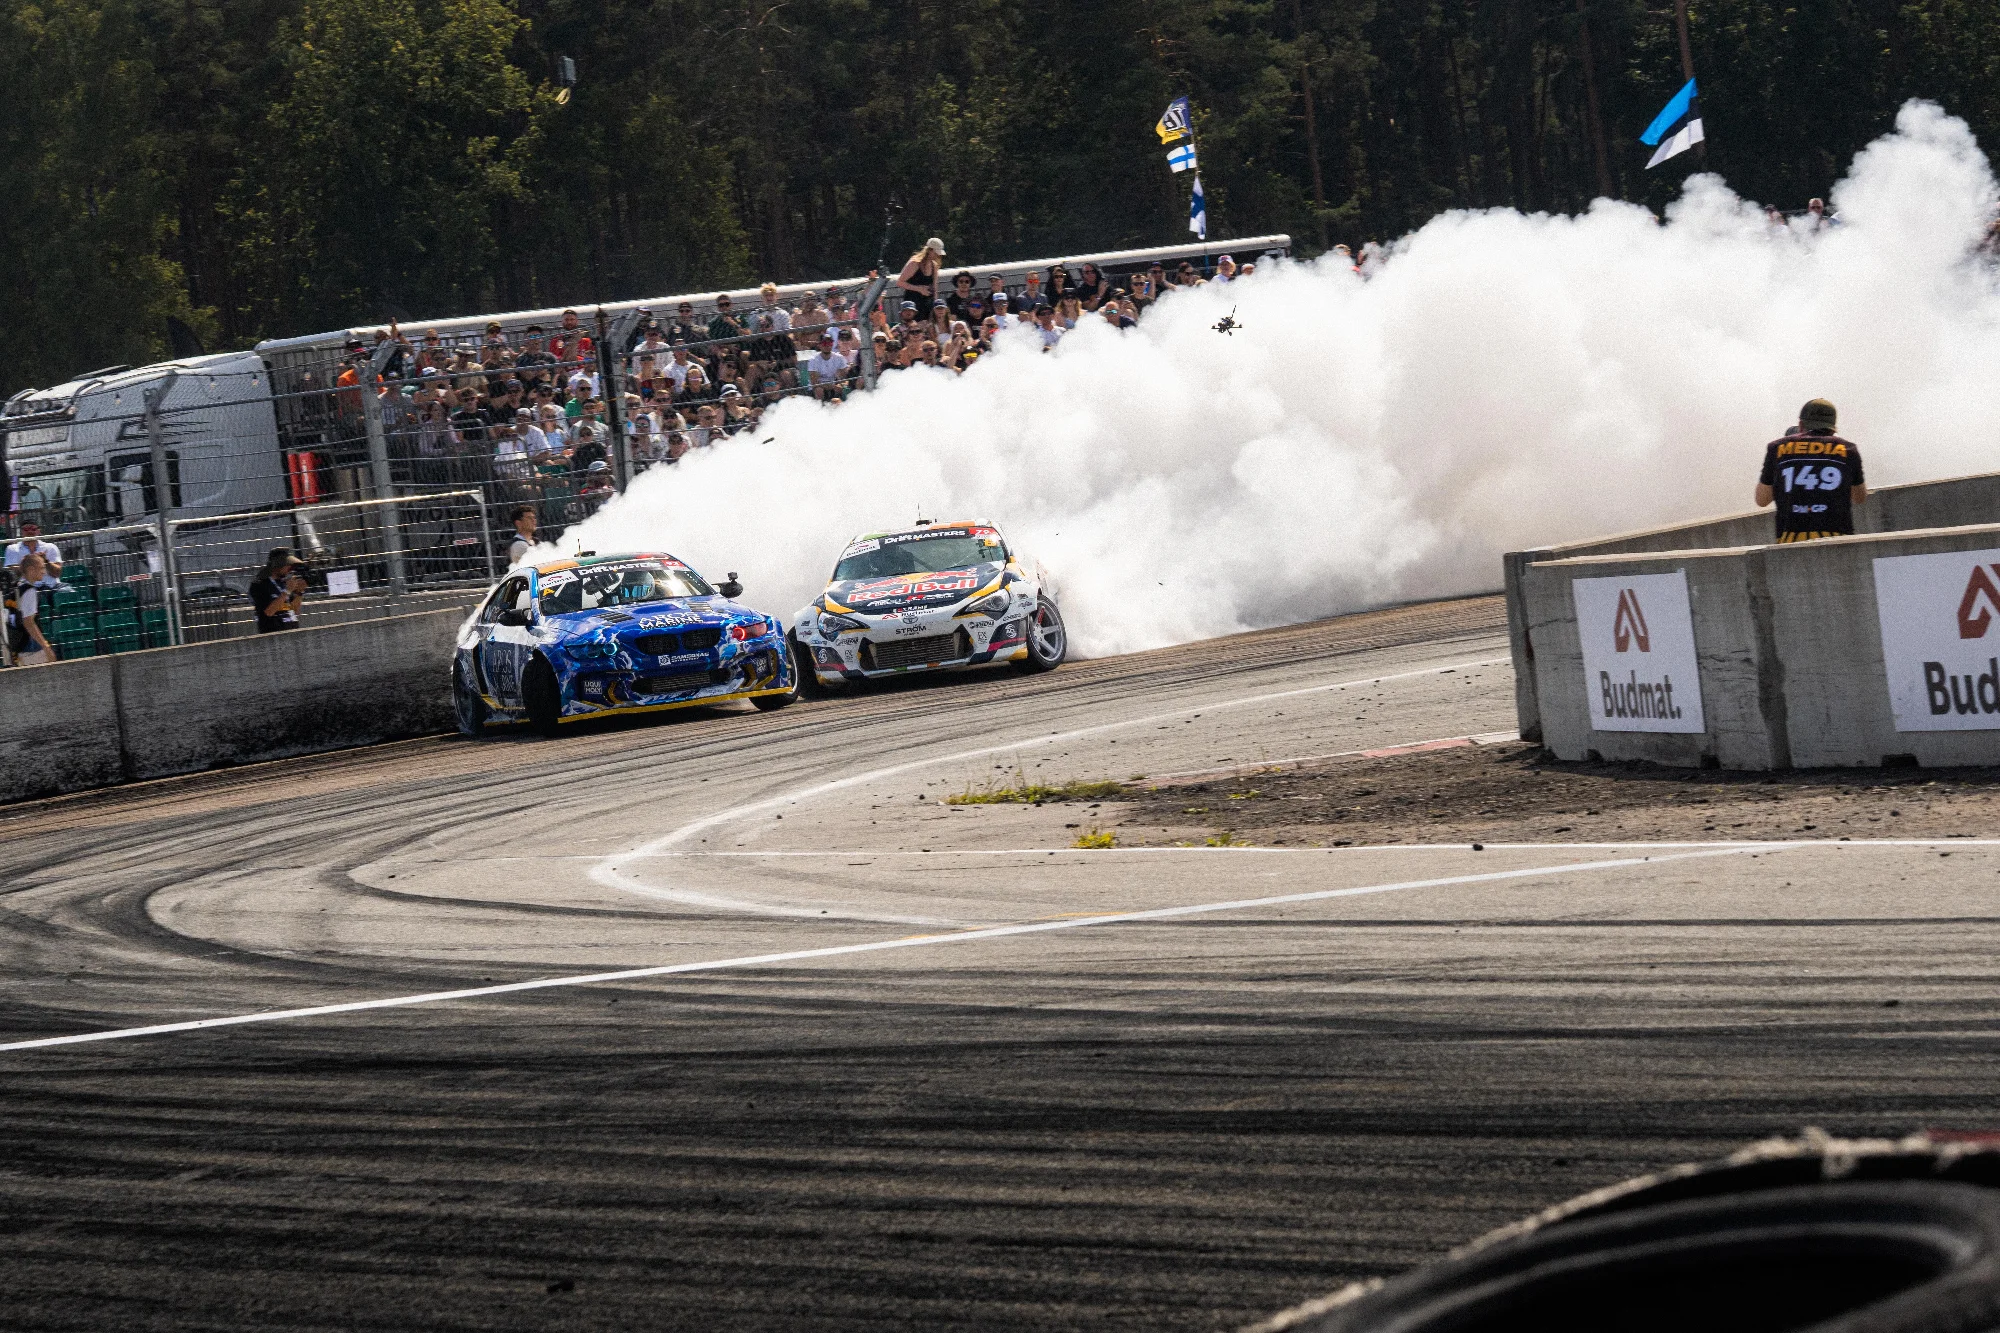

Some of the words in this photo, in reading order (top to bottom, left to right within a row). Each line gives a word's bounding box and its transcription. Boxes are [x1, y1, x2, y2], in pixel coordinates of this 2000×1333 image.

[1777, 442, 1847, 458] MEDIA
[1781, 465, 1842, 492] 149
[847, 584, 912, 603] Red
[914, 577, 978, 593] Bull
[1600, 669, 1682, 720] Budmat.
[1923, 657, 2000, 716] Bud
